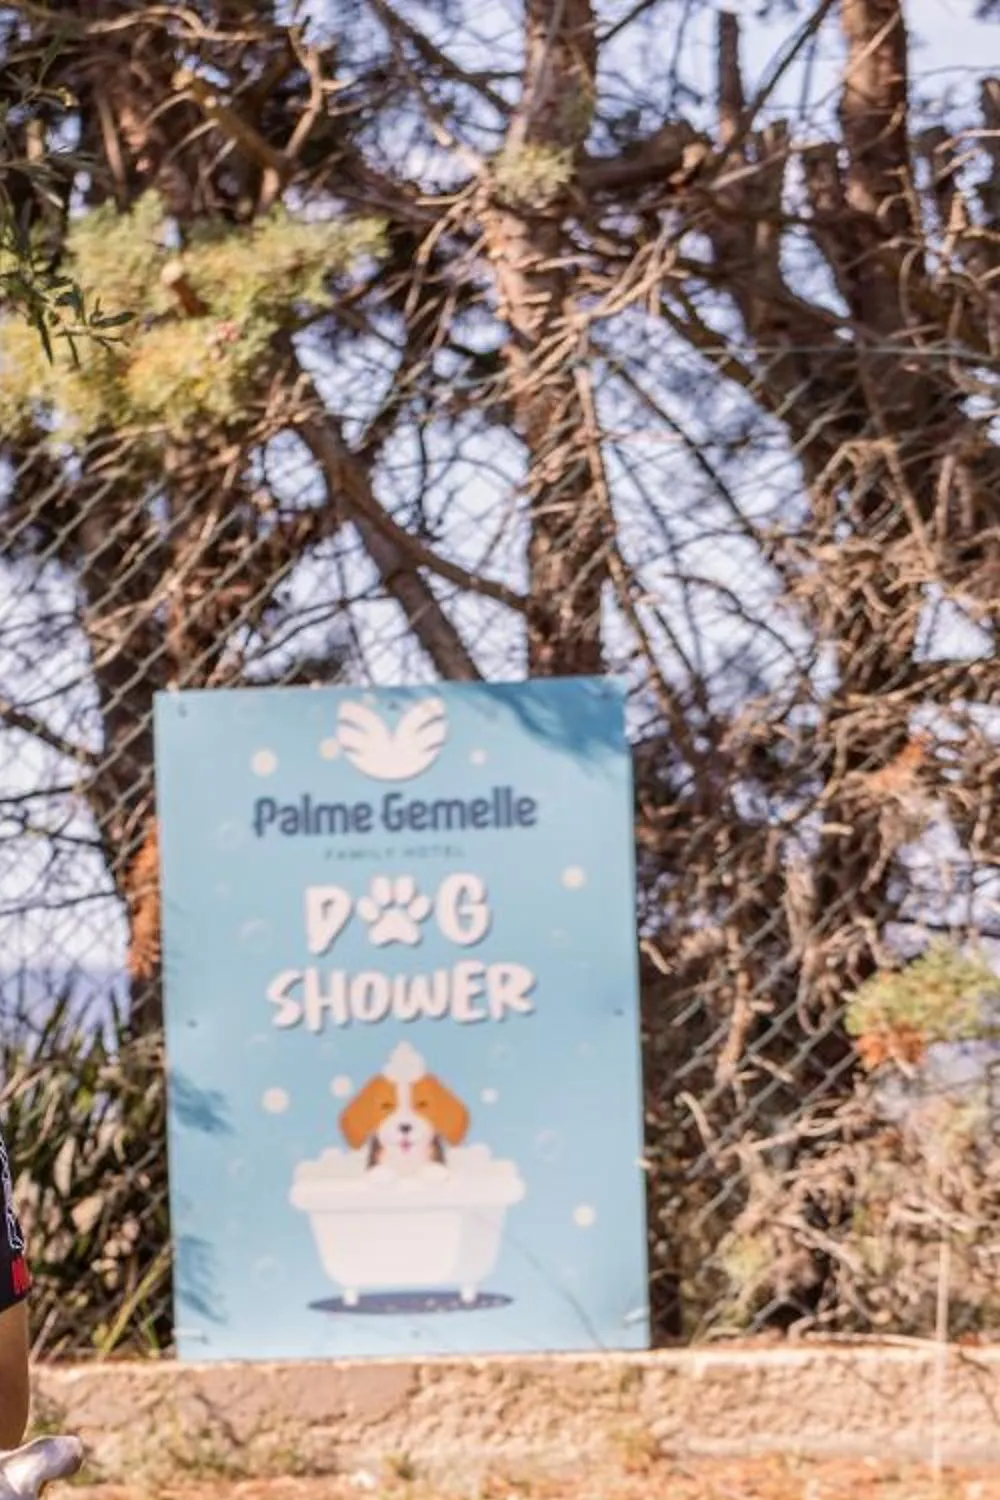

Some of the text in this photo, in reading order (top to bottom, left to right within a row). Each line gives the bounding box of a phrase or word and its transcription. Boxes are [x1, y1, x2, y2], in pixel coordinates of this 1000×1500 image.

[253, 786, 537, 837] Palme Gemelle
[304, 873, 491, 956] DG
[266, 959, 537, 1033] SHOWER
